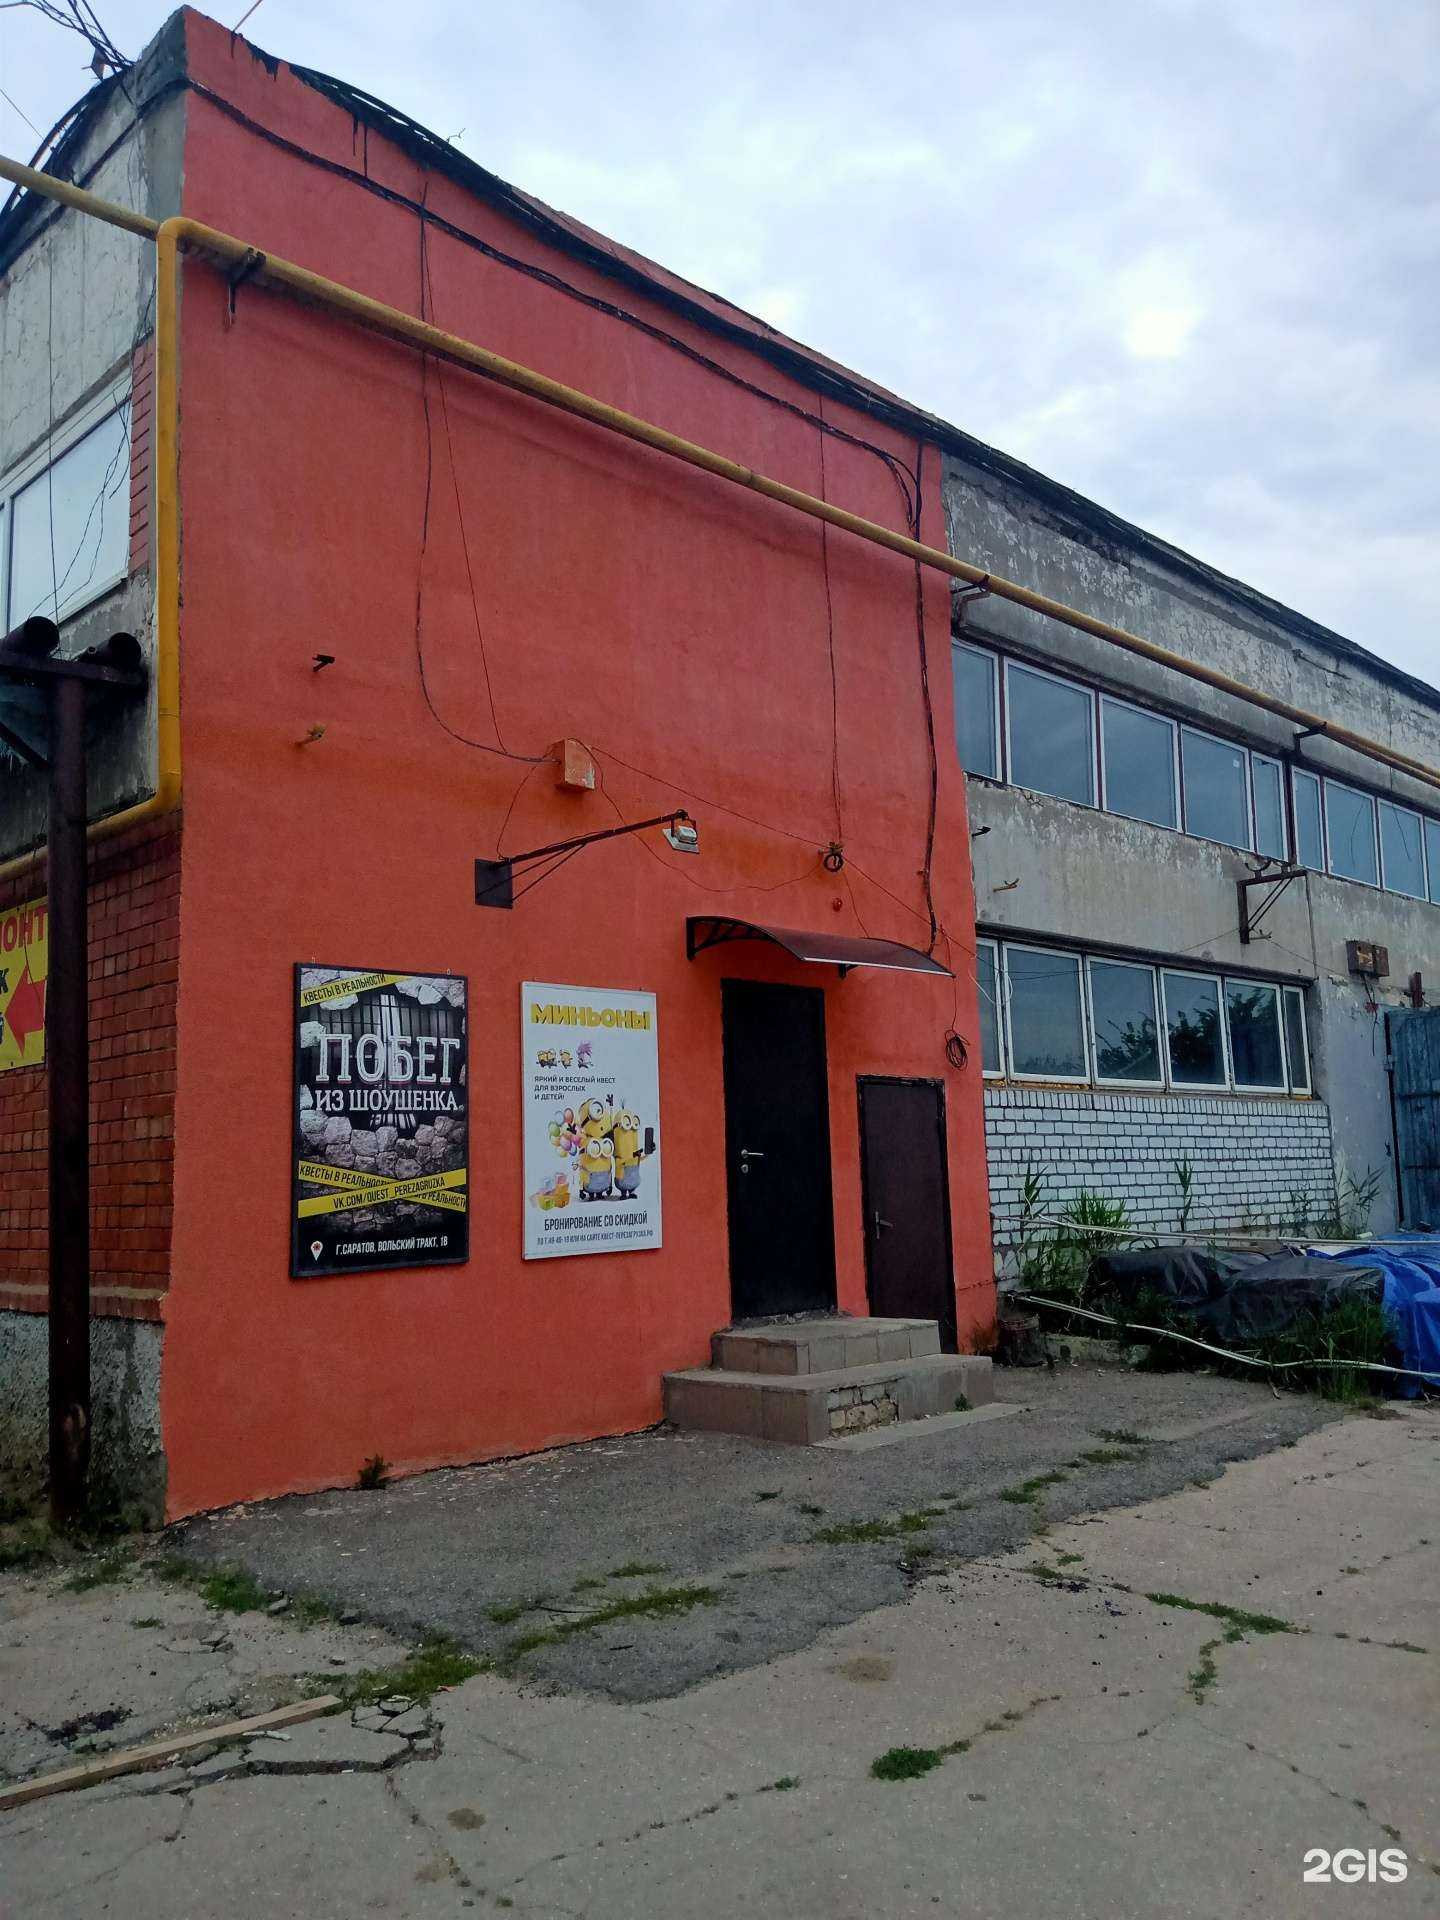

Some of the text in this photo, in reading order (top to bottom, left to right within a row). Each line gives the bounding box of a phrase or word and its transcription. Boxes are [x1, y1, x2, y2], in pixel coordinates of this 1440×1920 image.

[303, 973, 386, 1003] КВЕСТЫ В РЕАЛЬНОСТИ
[531, 1003, 650, 1030] МИНЬОНЫ
[315, 1033, 461, 1084] ПОБЕГ
[534, 1075, 557, 1083] ЯРКИЙ
[565, 1075, 595, 1083] ВЕСЕЛЫЙ
[315, 1089, 458, 1112] ИЗ ШОУШЕНКА
[299, 1164, 334, 1181] КВЕСТЫ
[334, 1171, 340, 1181] В
[544, 1210, 648, 1231] БРОНИРОВАНИЕ СО СКИДКОЙ
[377, 1237, 415, 1252] ВОЛЬСКИЙ
[440, 1235, 448, 1247] 18
